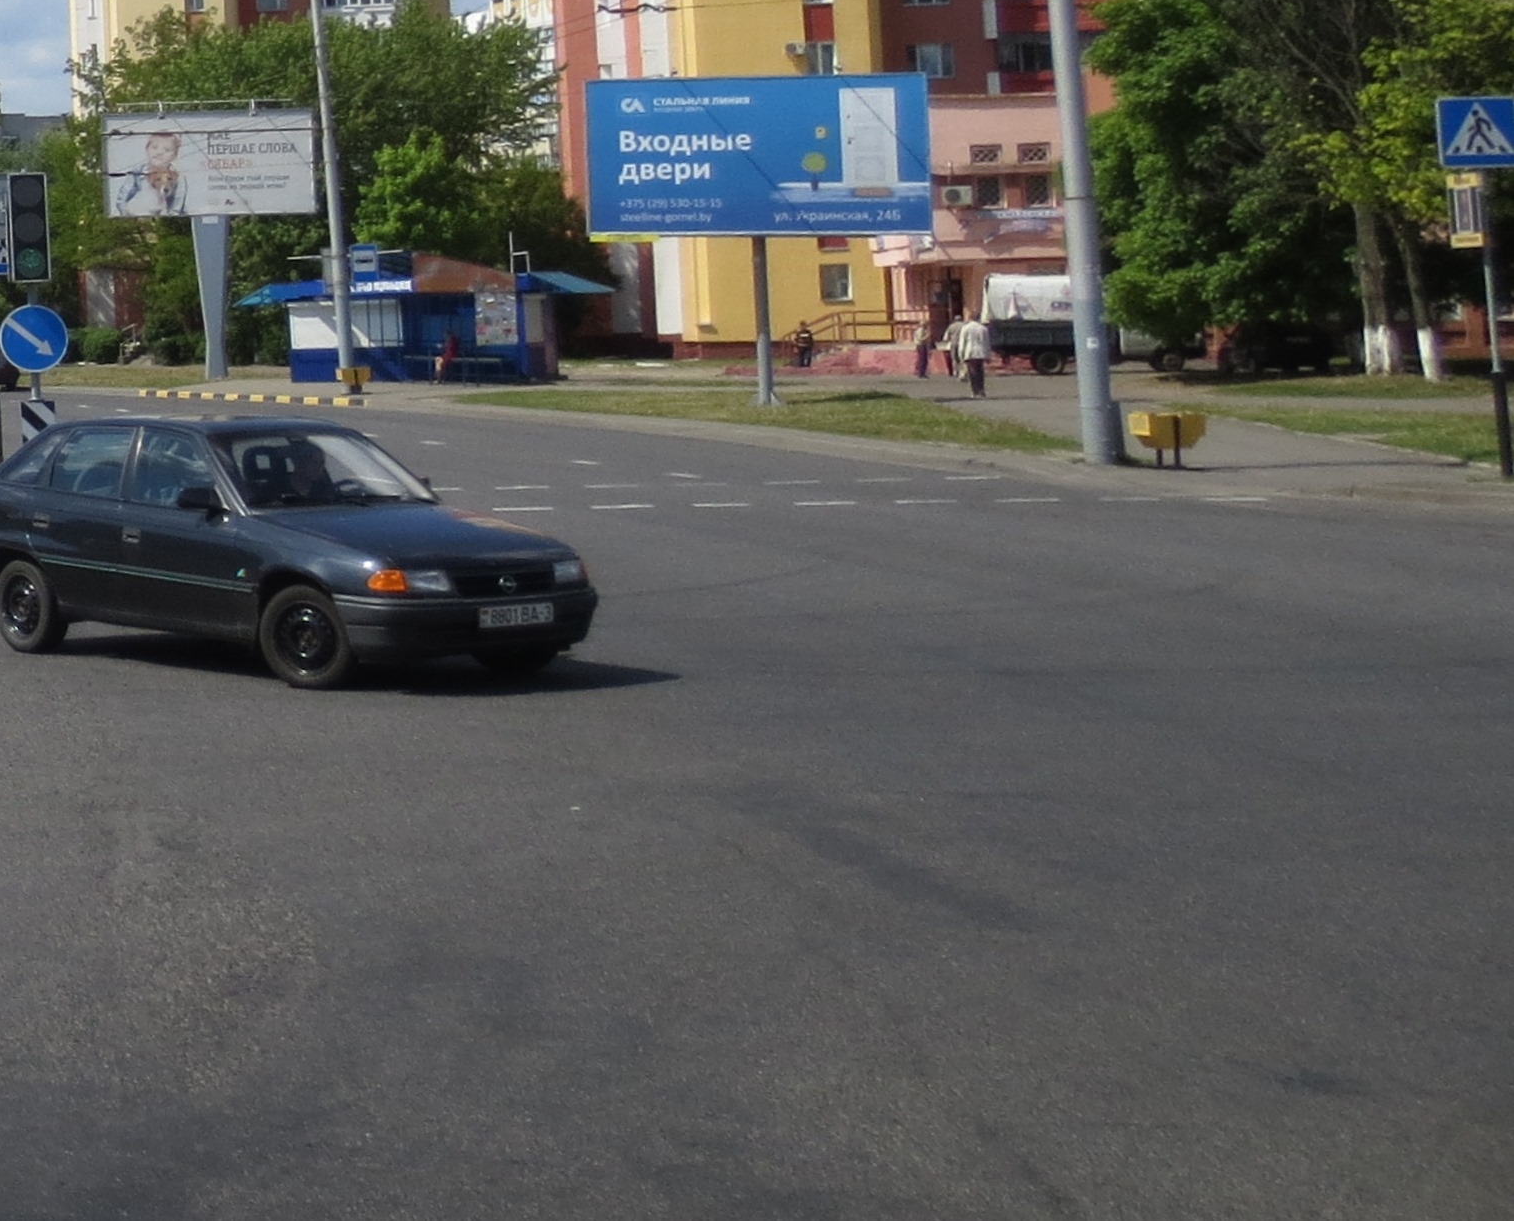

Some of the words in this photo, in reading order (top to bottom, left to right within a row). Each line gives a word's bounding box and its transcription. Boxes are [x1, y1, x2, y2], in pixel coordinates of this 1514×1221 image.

[207, 142, 256, 155] ПЕРШАЕ
[258, 142, 297, 154] СЛОВА
[619, 130, 752, 156] Входные
[618, 162, 711, 185] двери
